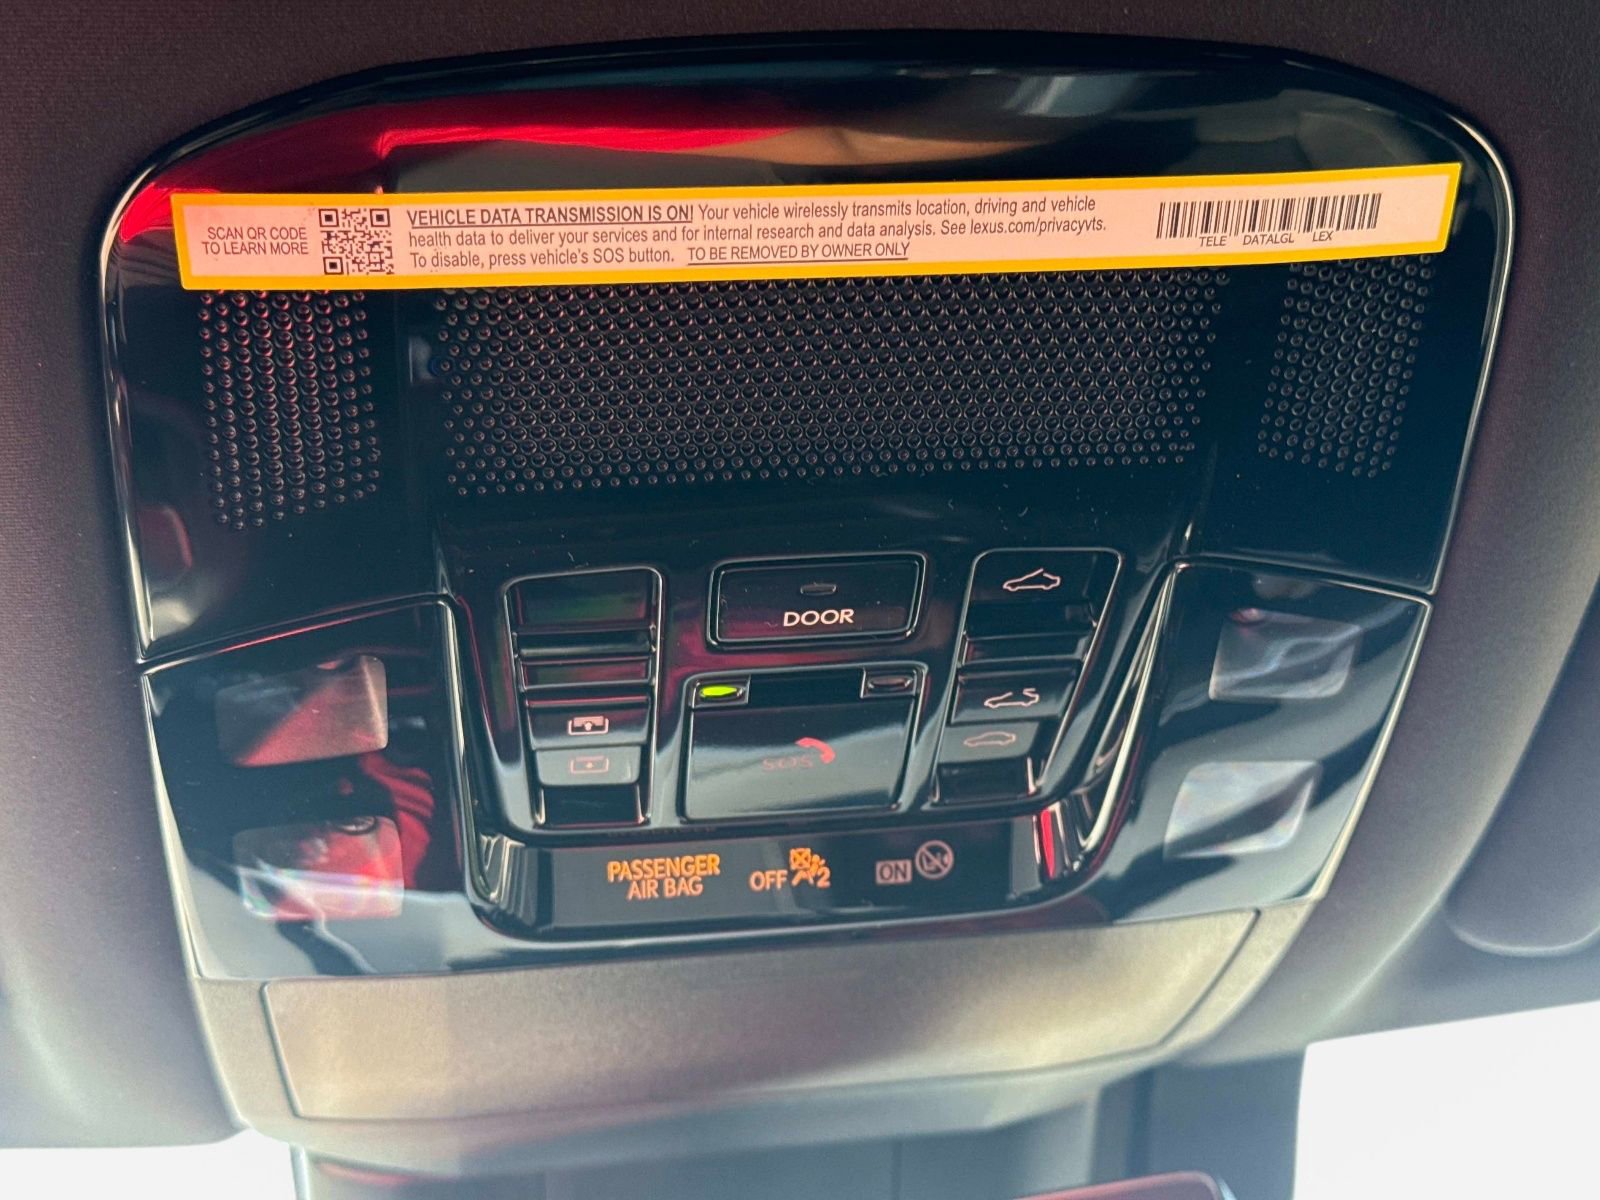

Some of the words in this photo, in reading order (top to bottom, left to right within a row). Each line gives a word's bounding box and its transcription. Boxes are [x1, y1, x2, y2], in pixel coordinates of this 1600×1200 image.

[407, 209, 476, 225] VEHICLE
[481, 207, 521, 224] DATA
[525, 205, 643, 222] TRANSMISSION
[649, 205, 661, 221] IS
[666, 204, 693, 221] ON!
[698, 204, 729, 220] Your
[732, 202, 779, 220] vehicle
[783, 201, 849, 221] wirelessly
[852, 200, 912, 217] transmits
[916, 198, 970, 217] location,
[974, 197, 1017, 216] driving
[1022, 196, 1046, 213] and
[1050, 195, 1096, 212] vehicle
[207, 226, 244, 240] SCAN
[247, 226, 267, 240] QR
[271, 226, 307, 240] CODE
[408, 231, 451, 247] health
[456, 230, 485, 246] data
[491, 230, 503, 245] to
[509, 228, 554, 245] deliver
[558, 230, 588, 247] your
[592, 227, 648, 244] services
[652, 226, 677, 242] and
[682, 225, 699, 241] for
[703, 223, 752, 241] internal
[757, 222, 814, 240] research
[818, 221, 843, 238] and
[847, 220, 876, 237] data
[879, 219, 936, 240] analysis.
[941, 219, 966, 235] See
[970, 216, 1106, 237] lexus.com/privacyvts.
[1199, 235, 1227, 247] TELE
[1243, 232, 1295, 246] DATALGL
[1312, 230, 1334, 242] LEX
[202, 241, 221, 255] TO
[224, 241, 266, 255] LEARN
[270, 241, 309, 255] MORE
[410, 252, 427, 268] To
[431, 251, 485, 268] disable,
[489, 251, 526, 270] press
[530, 248, 589, 265] vehicle's
[593, 248, 625, 264] SOS
[629, 246, 675, 263] button.
[687, 247, 706, 261] TO
[709, 246, 727, 260] BE
[731, 245, 798, 260] REMOVED
[801, 244, 819, 259] BY
[821, 243, 872, 258] OWNER
[875, 242, 910, 257] ONLY
[783, 608, 855, 627] DOOR
[606, 853, 721, 883] PASSENGER
[879, 862, 908, 882] ON
[627, 878, 658, 901] AIR
[664, 876, 703, 898] BAG
[749, 869, 788, 892] OFF
